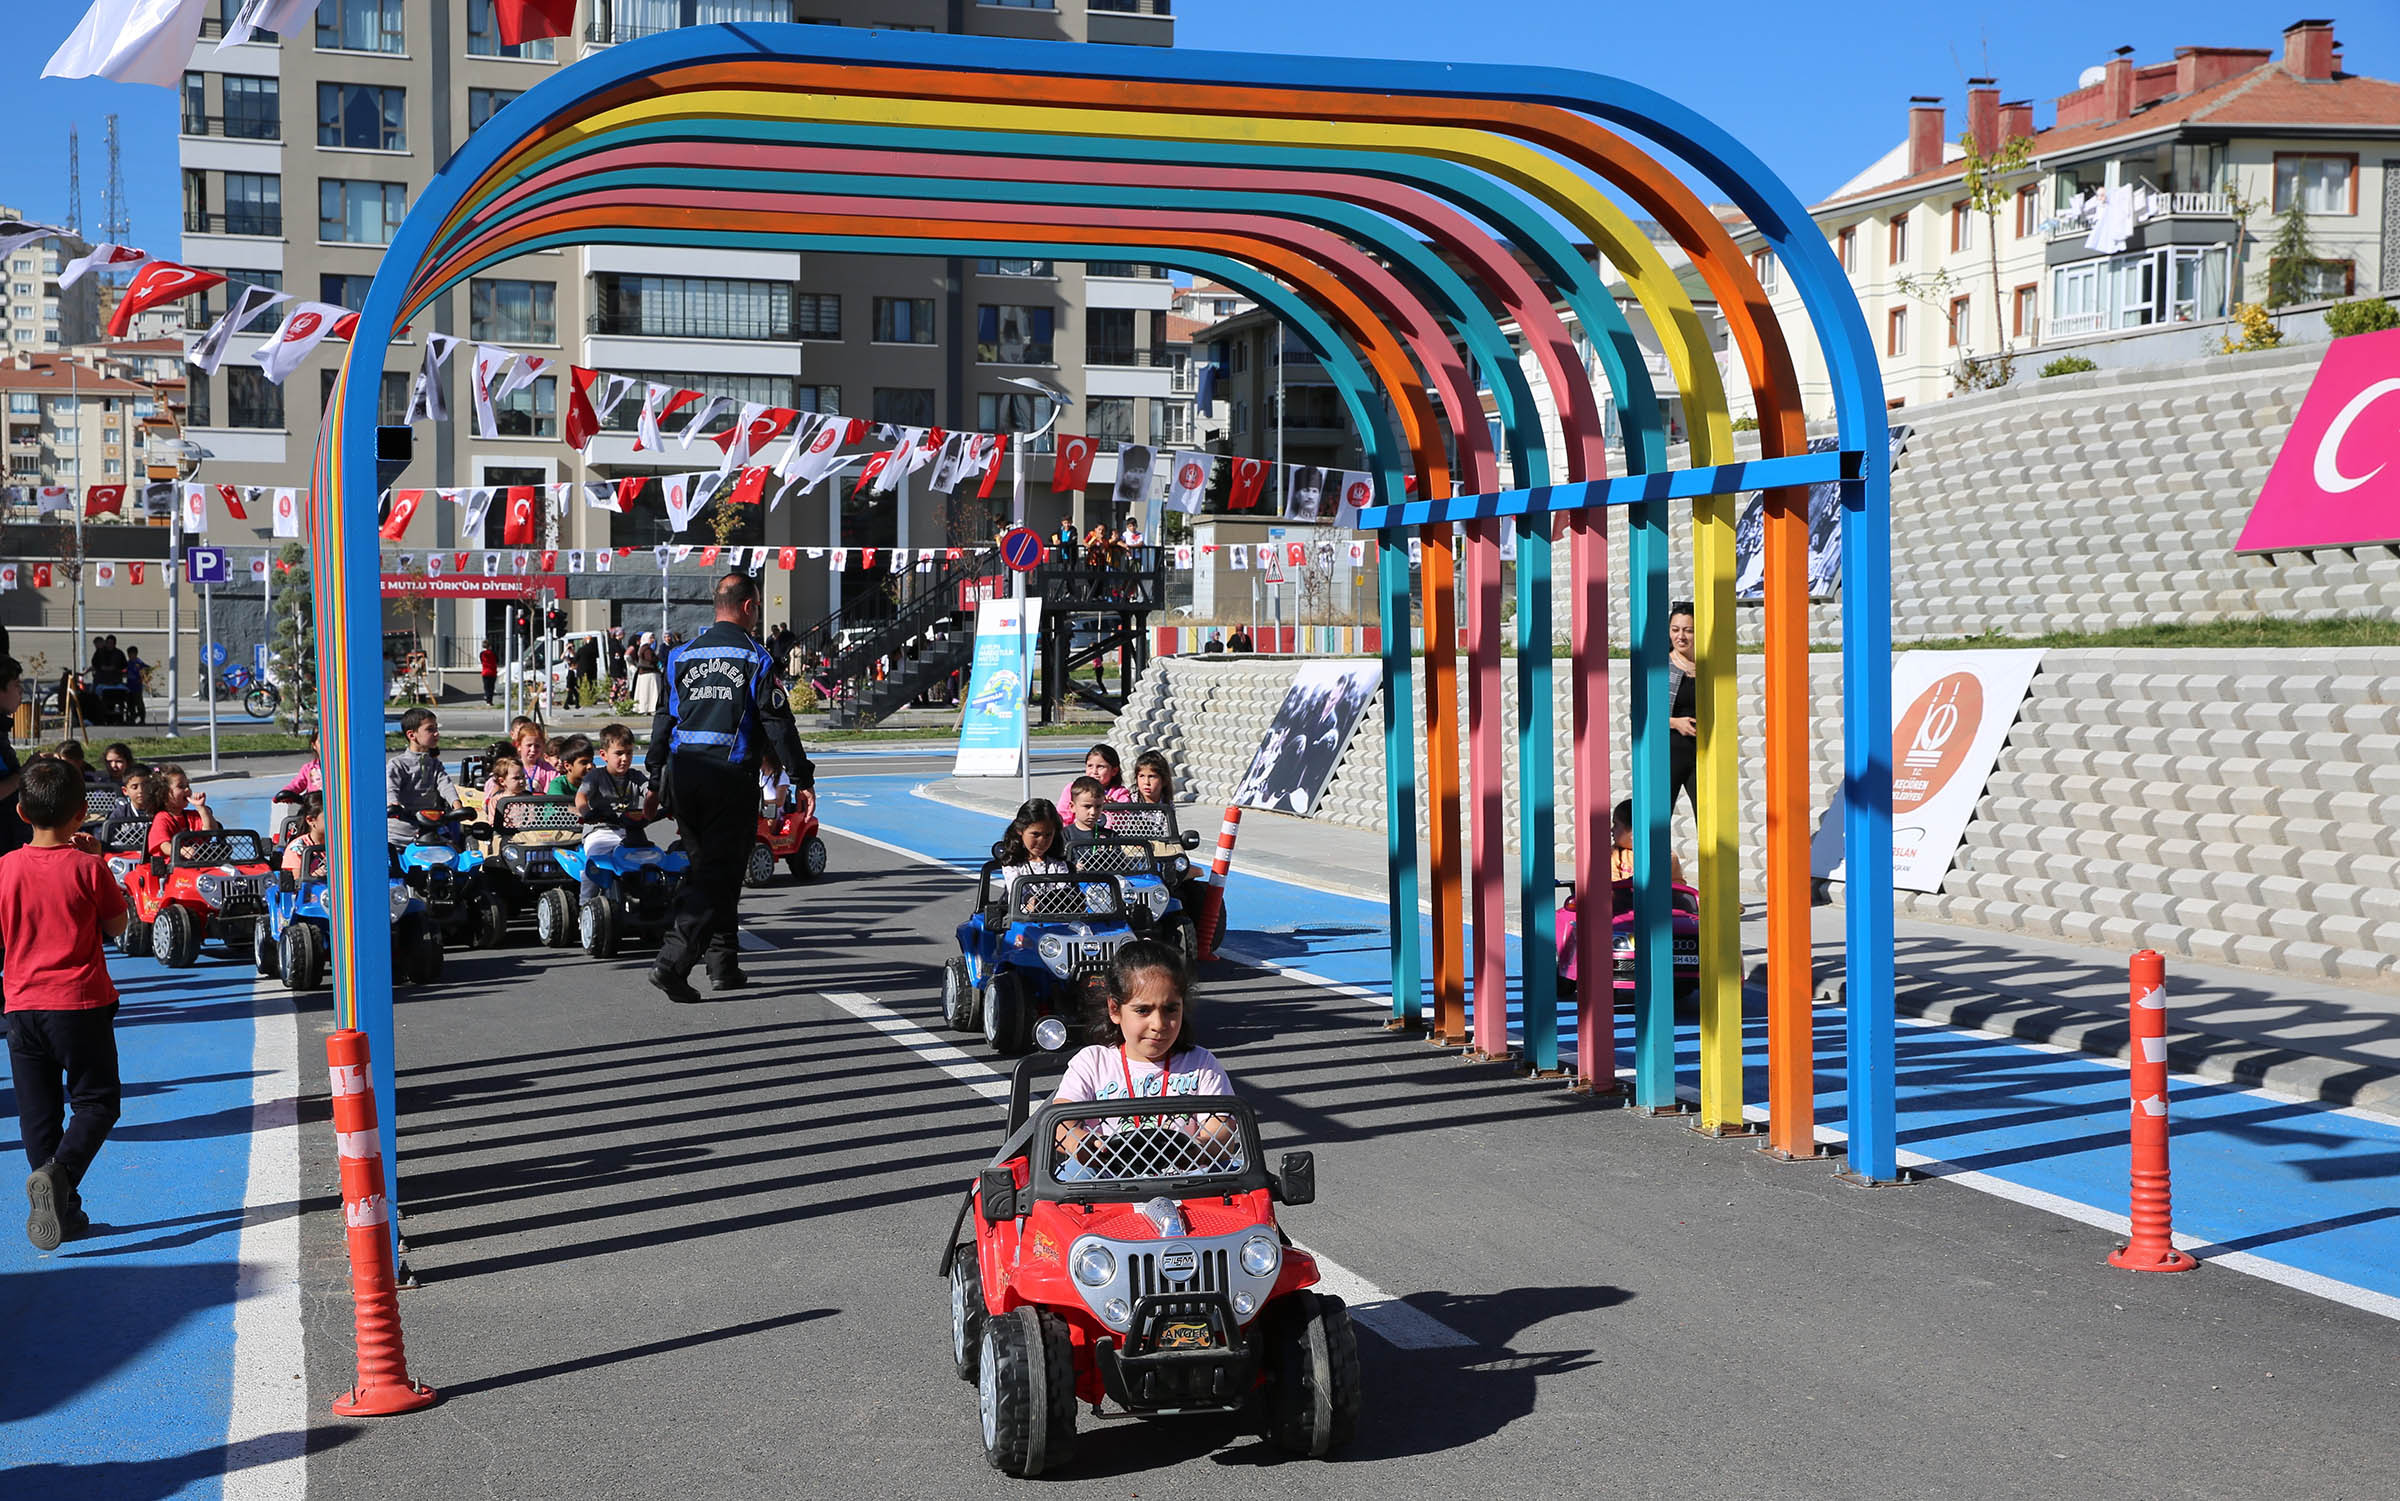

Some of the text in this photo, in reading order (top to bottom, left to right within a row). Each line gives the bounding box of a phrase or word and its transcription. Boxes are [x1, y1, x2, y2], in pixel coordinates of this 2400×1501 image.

[196, 551, 217, 578] P
[388, 581, 427, 590] MUTLU
[689, 686, 732, 700] ZABITA
